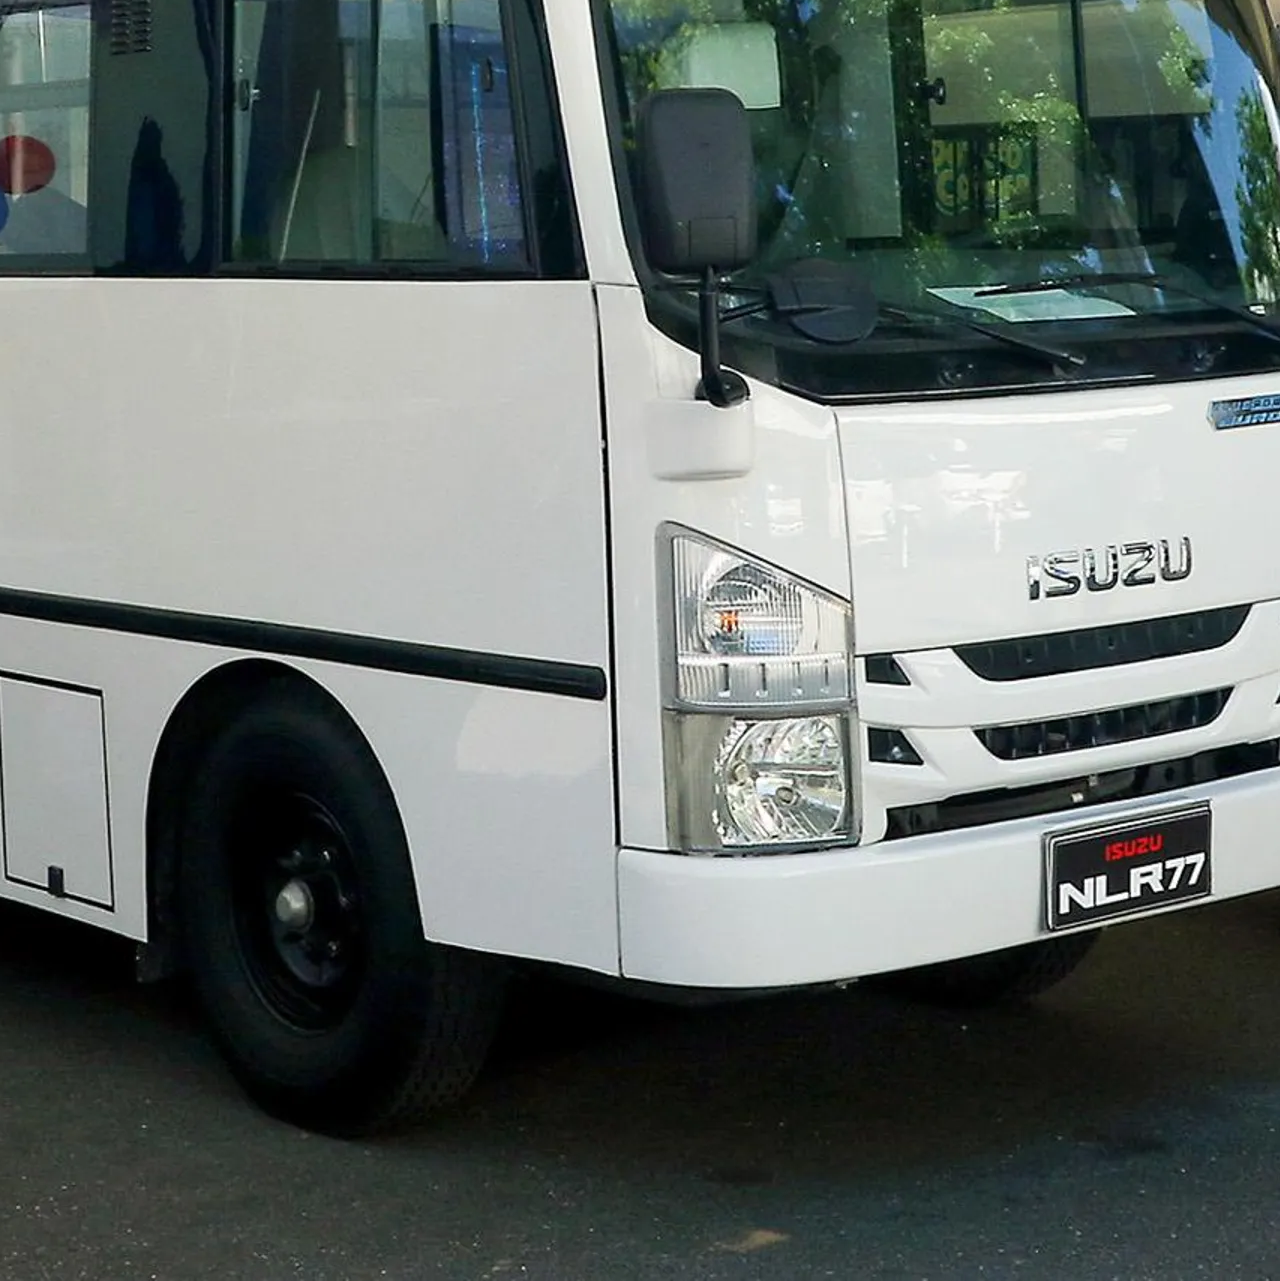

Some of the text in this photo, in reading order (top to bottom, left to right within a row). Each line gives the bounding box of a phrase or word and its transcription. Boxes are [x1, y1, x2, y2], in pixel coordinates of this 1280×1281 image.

[1026, 536, 1192, 601] ISUZU
[1104, 833, 1164, 862] ISUZU
[1058, 852, 1206, 915] NLR77
